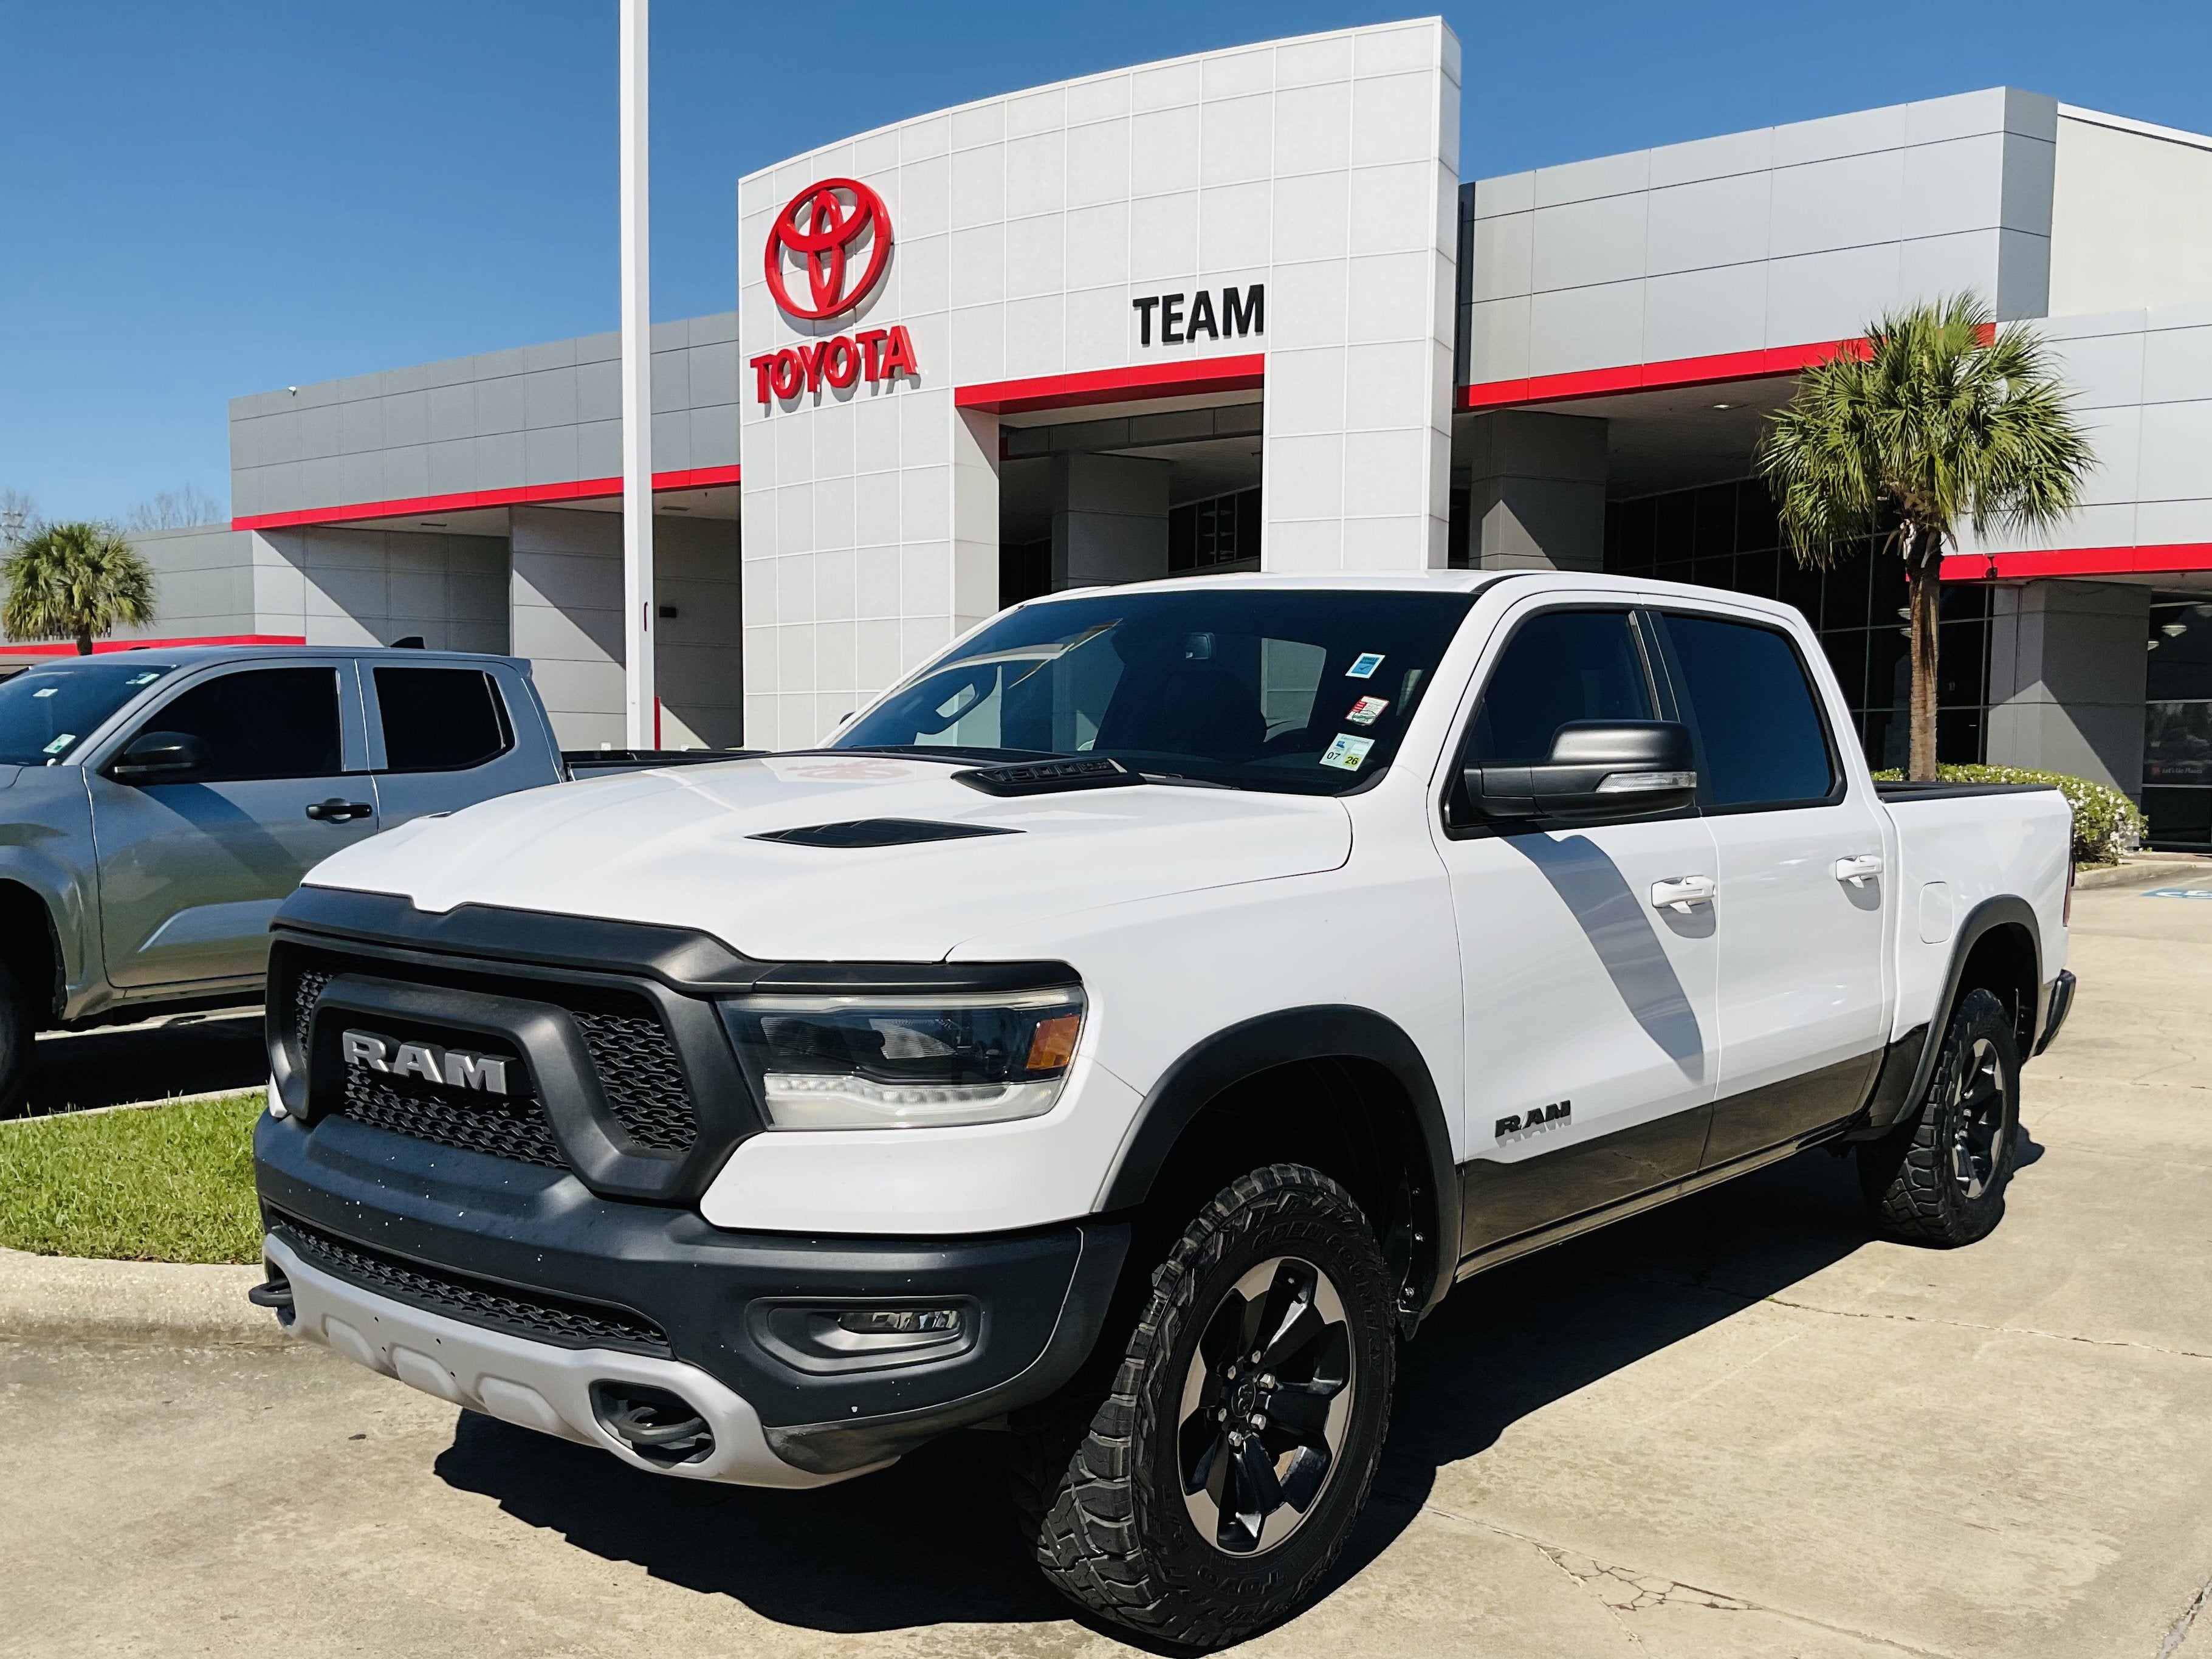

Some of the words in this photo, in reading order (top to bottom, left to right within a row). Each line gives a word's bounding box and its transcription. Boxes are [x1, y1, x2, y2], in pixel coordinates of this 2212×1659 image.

[1132, 284, 1265, 346] TEAM
[750, 325, 919, 404] TOYOTA
[994, 764, 1081, 782] 1500
[1327, 752, 1341, 760] 07
[1345, 756, 1359, 765] 26
[343, 1029, 508, 1095] RAM
[1494, 1099, 1571, 1138] RAM
[1252, 1220, 1327, 1250] OPEN
